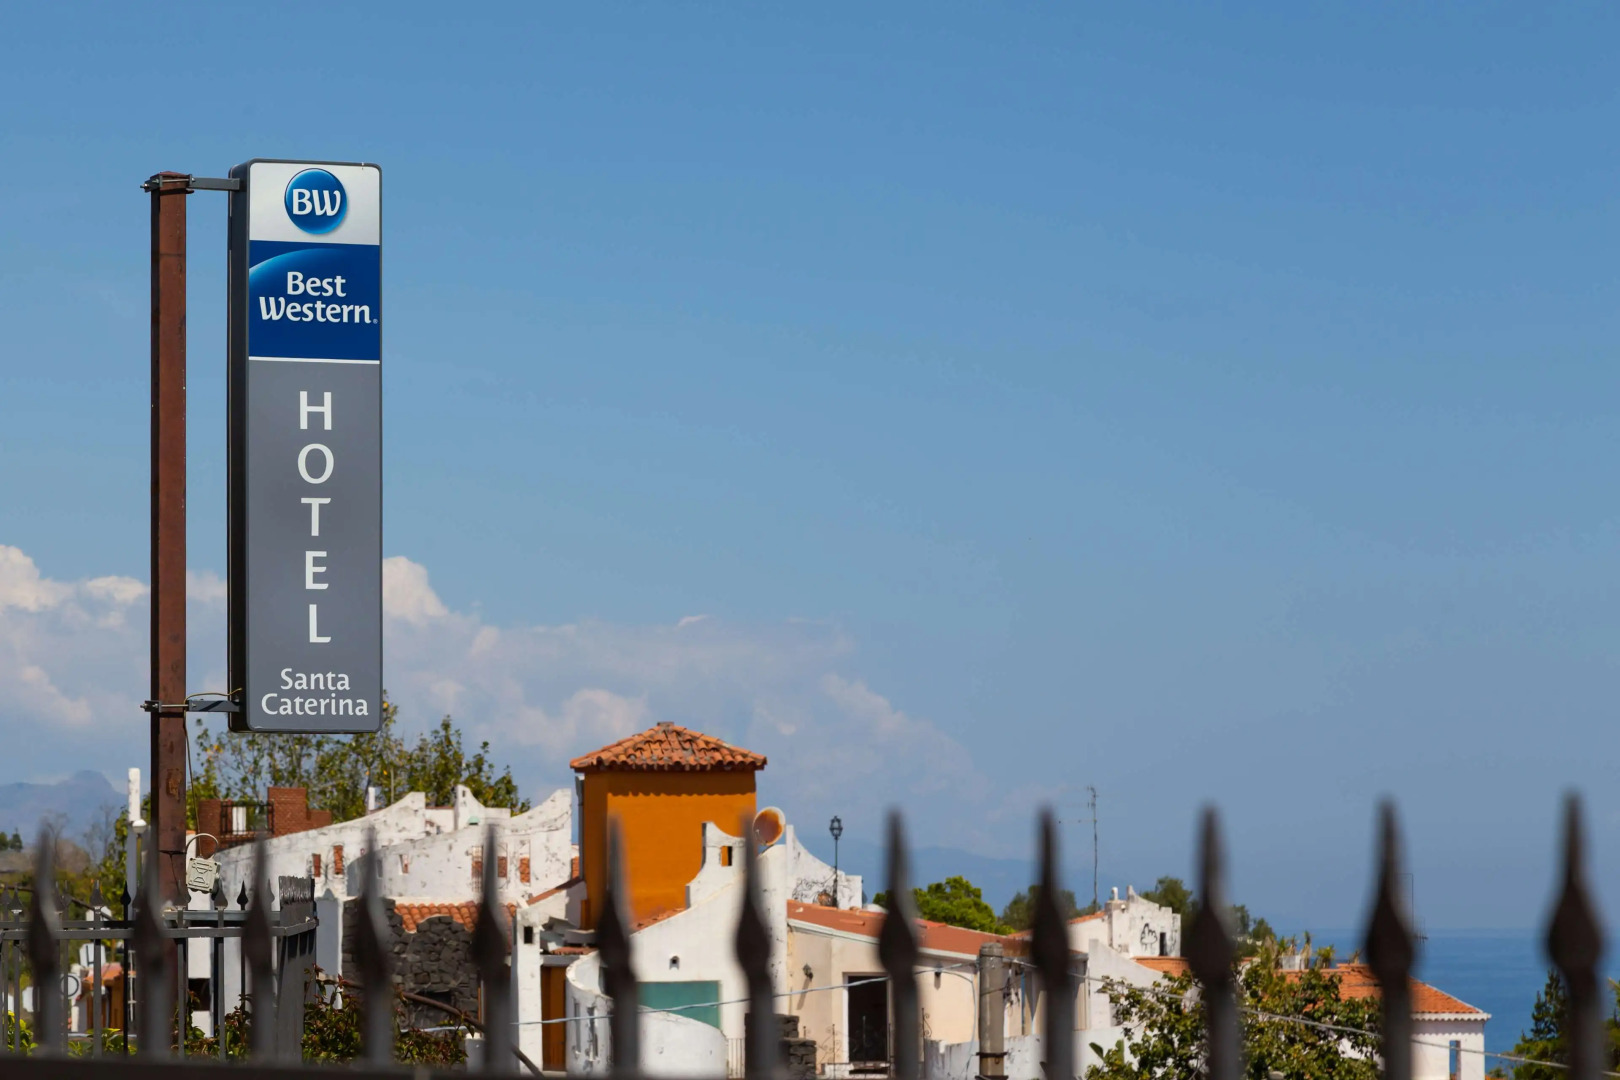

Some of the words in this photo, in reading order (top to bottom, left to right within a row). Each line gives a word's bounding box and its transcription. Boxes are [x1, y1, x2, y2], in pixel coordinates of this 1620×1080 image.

[292, 188, 342, 217] BW
[286, 271, 347, 297] Best
[298, 390, 335, 644] HOTEL
[280, 668, 351, 691] Santa
[261, 693, 369, 716] Caterina
